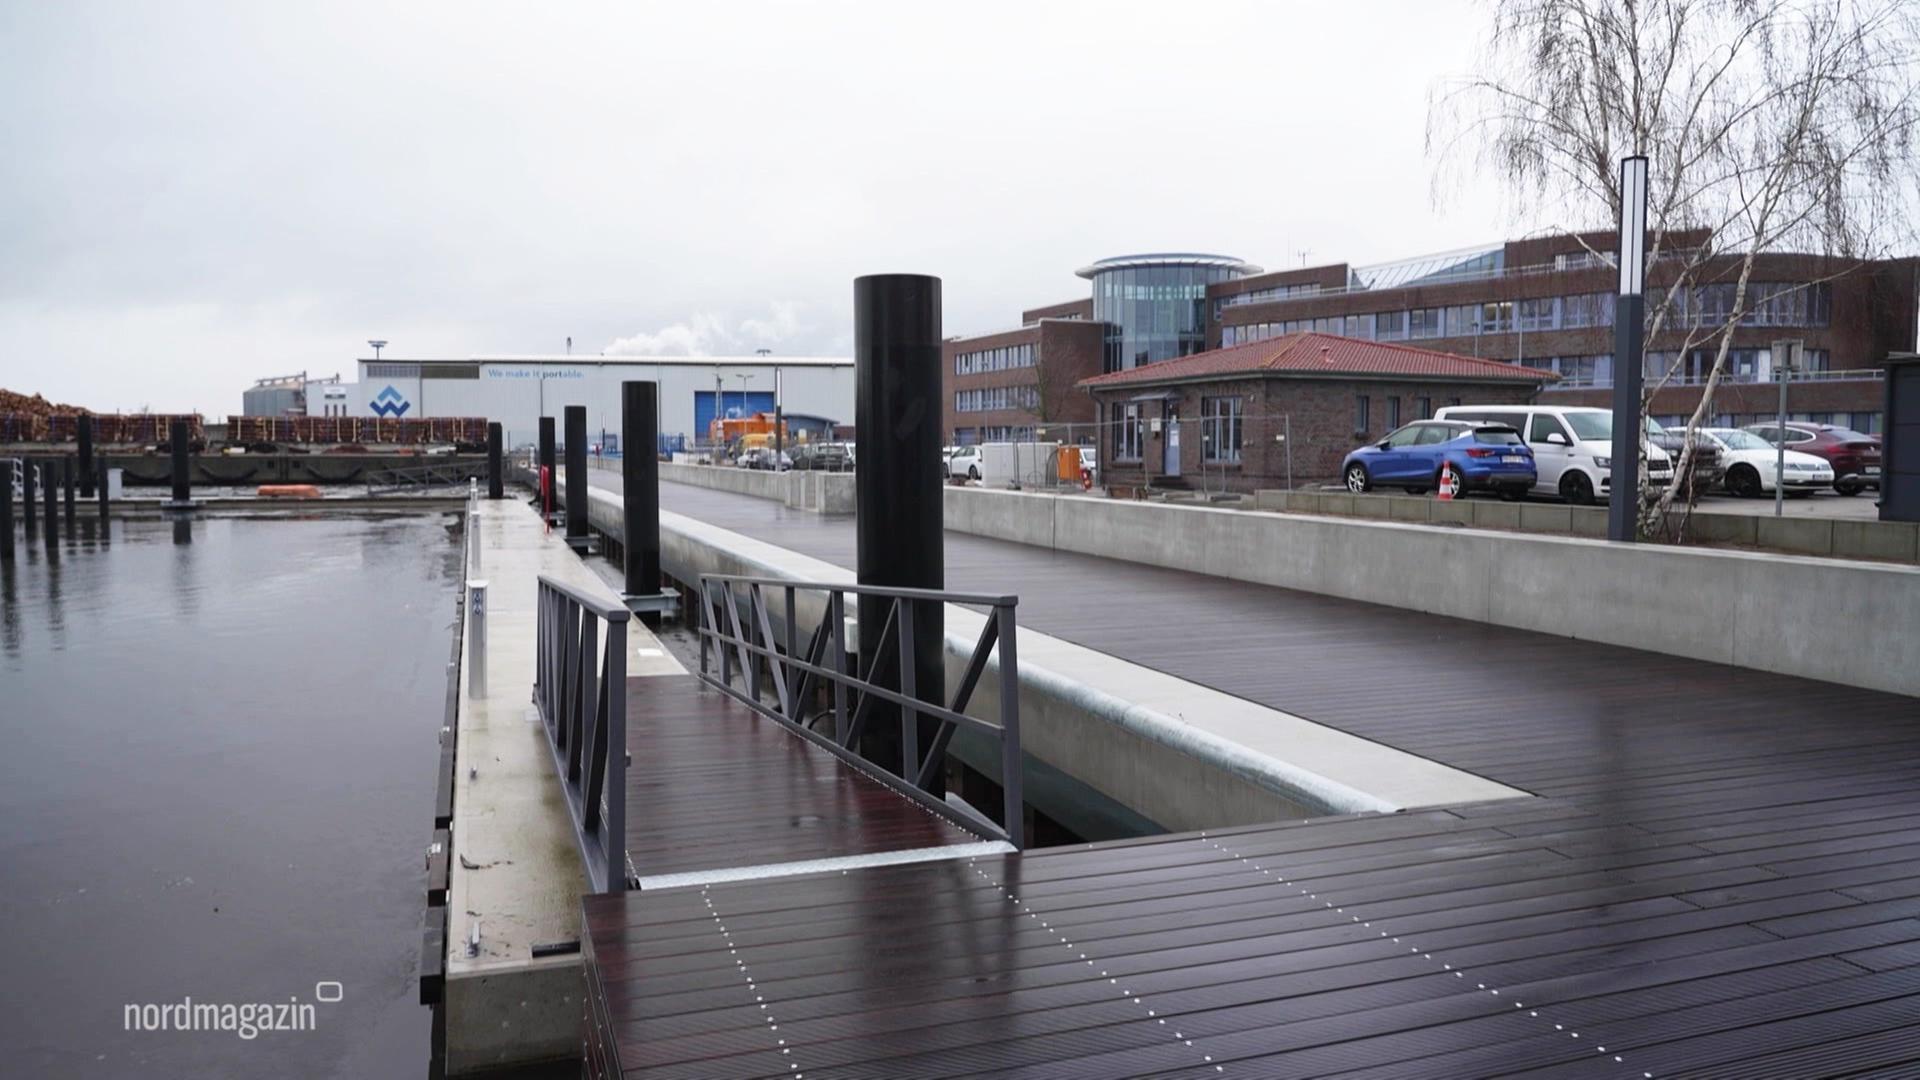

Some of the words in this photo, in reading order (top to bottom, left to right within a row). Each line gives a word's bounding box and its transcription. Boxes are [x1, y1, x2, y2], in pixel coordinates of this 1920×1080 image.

[488, 369, 503, 377] We
[506, 369, 530, 377] make
[533, 369, 540, 377] it
